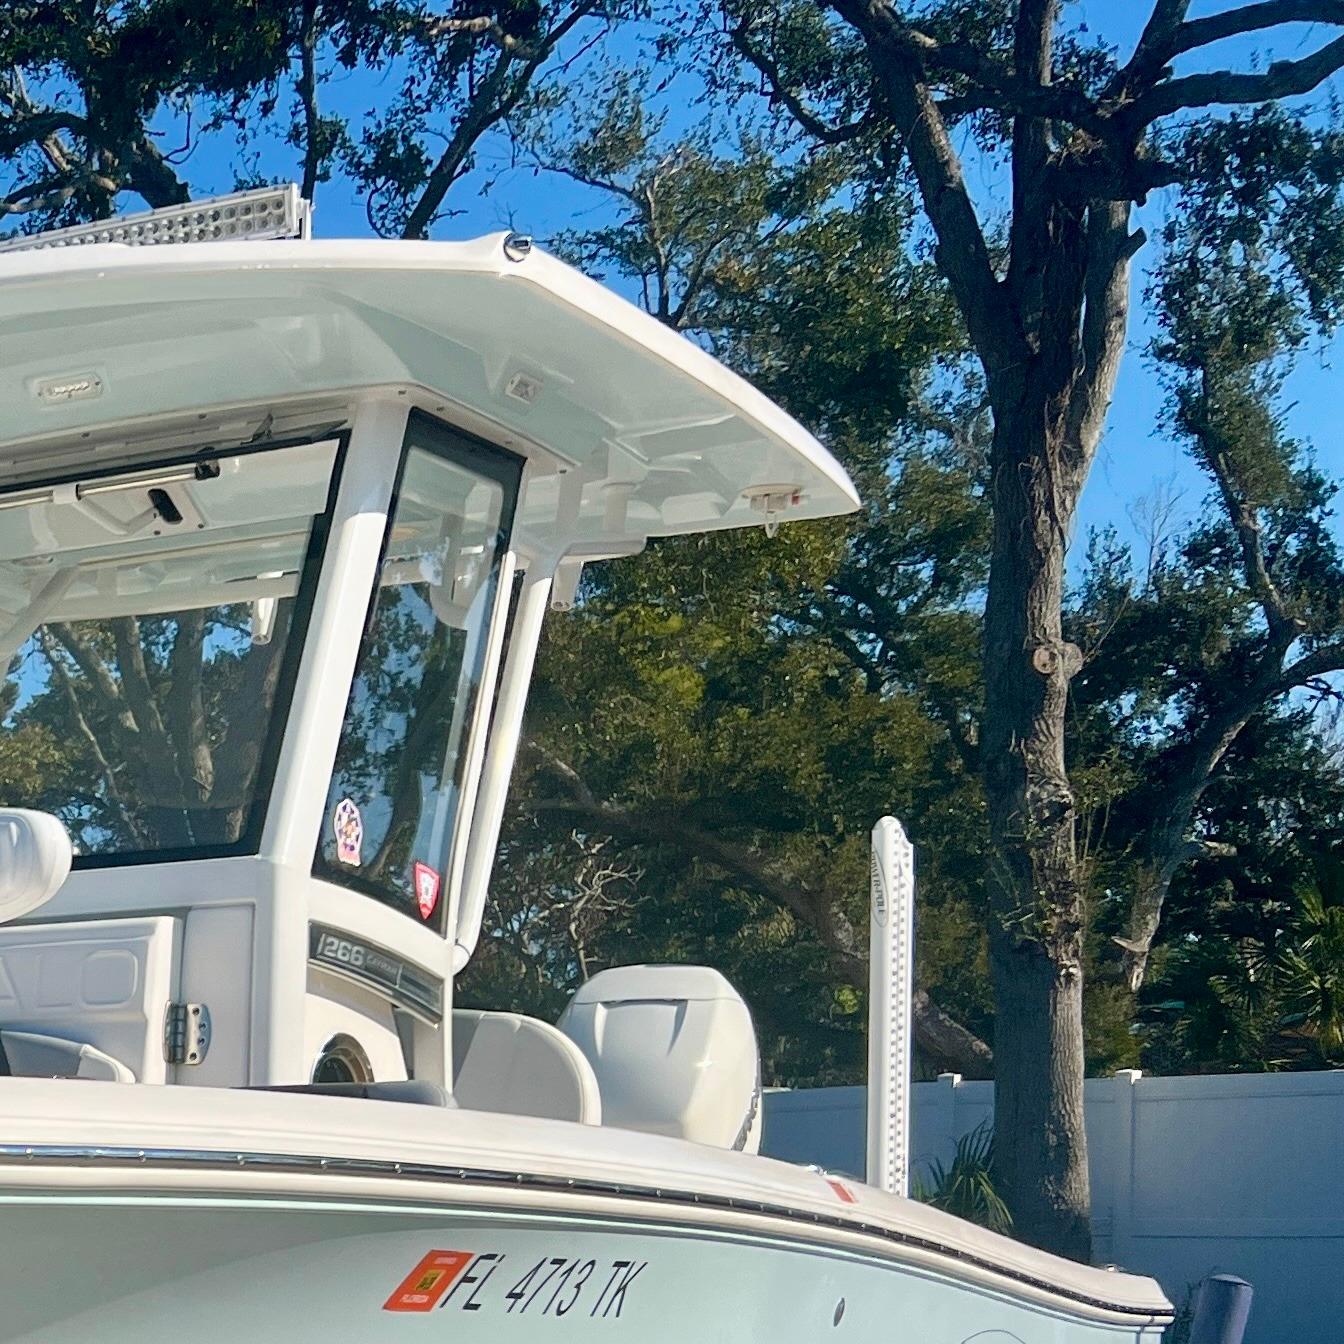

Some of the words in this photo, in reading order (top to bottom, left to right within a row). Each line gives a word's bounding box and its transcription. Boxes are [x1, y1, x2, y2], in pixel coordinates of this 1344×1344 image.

[440, 1254, 506, 1311] FL
[505, 1257, 597, 1317] 4713
[590, 1260, 649, 1318] TK
